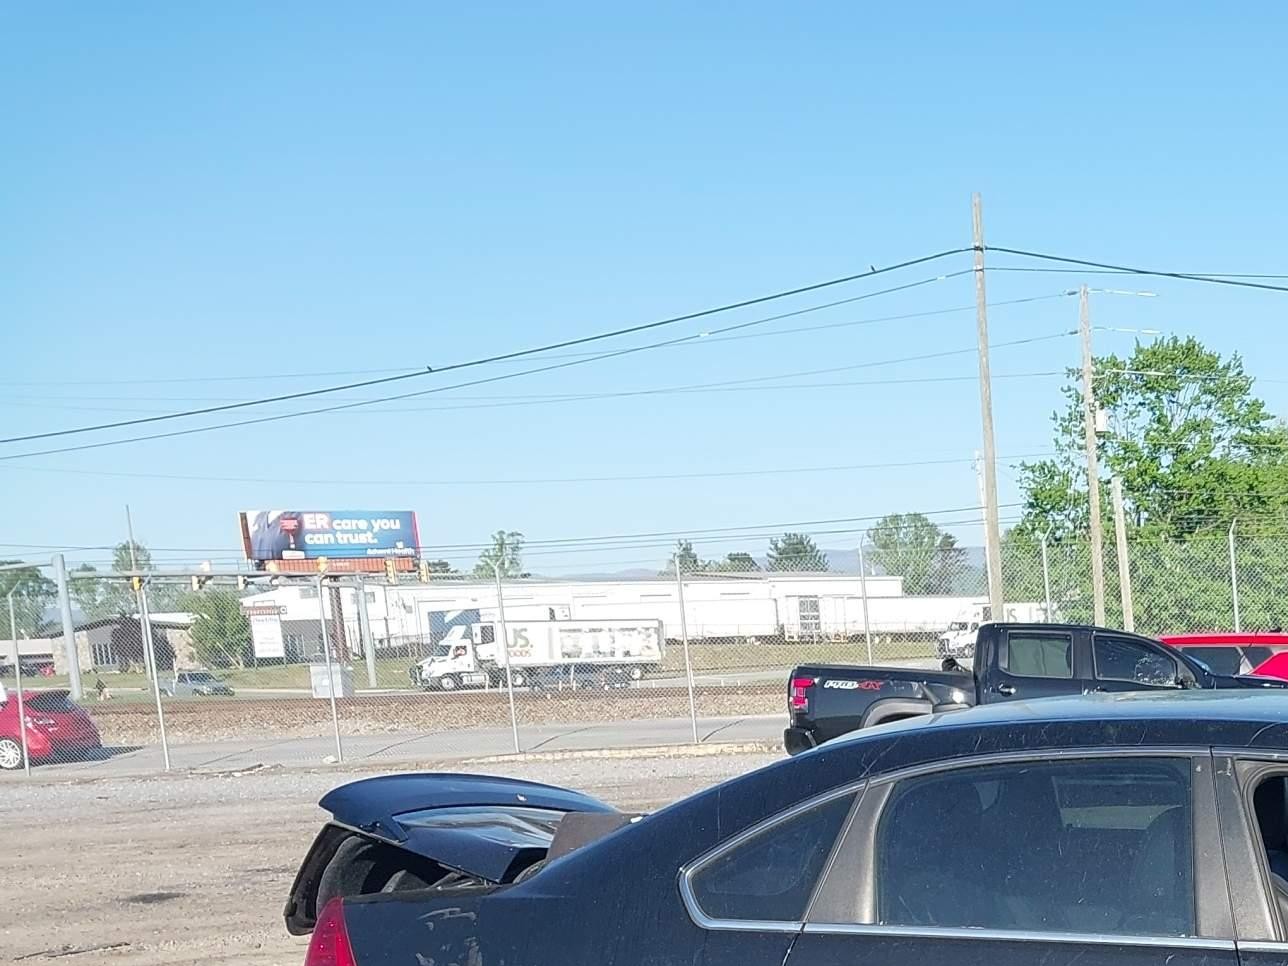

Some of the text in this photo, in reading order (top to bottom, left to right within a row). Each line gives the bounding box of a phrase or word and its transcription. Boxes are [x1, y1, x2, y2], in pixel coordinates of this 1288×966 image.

[303, 513, 400, 535] ER care you
[304, 532, 378, 545] can trust.
